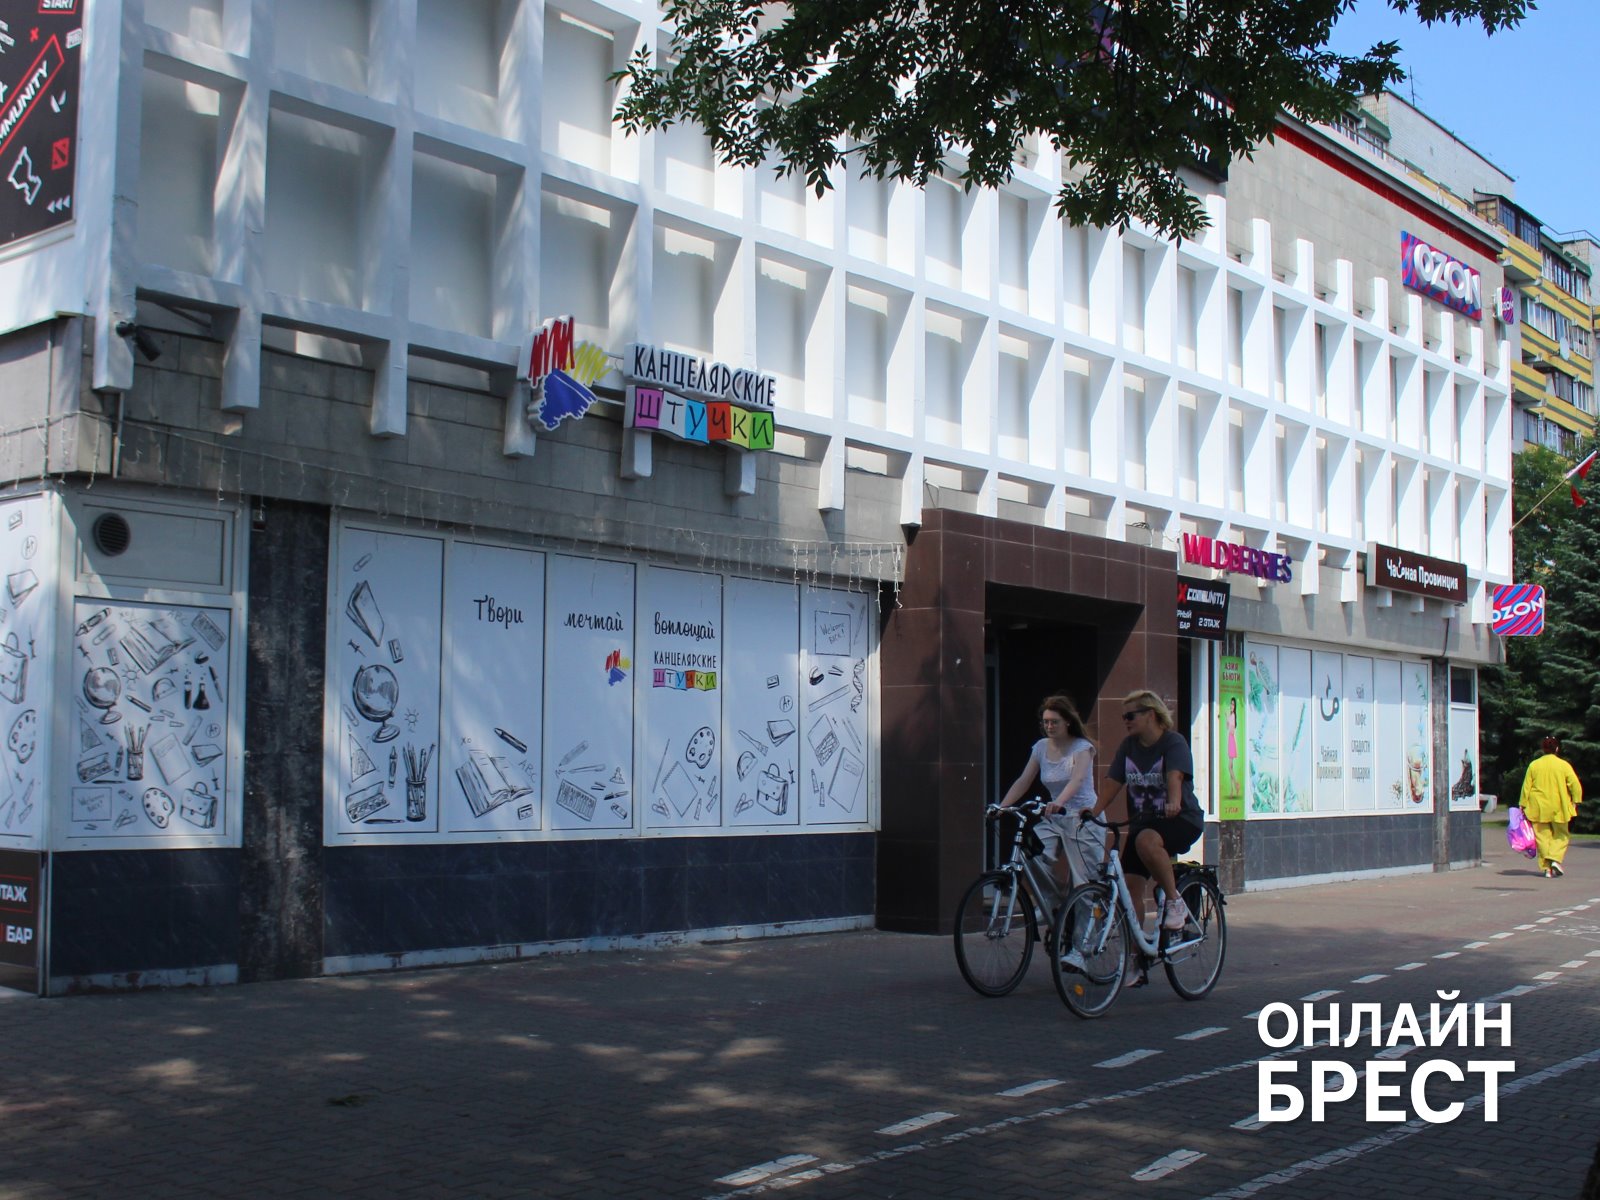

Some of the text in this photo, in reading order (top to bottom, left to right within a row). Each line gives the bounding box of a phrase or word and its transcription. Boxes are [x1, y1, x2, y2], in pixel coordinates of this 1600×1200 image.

[1413, 243, 1481, 311] OZON
[634, 344, 776, 407] КАНЦЕЛЯРСКИЕ
[637, 391, 772, 446] ШТУЧКИ
[1183, 532, 1293, 583] WILDBERRIES
[1418, 565, 1459, 592] Провинция
[473, 594, 715, 642] Твори мечтай воплощай
[1180, 621, 1191, 630] БАР
[654, 650, 717, 669] КАНЦЕЛЯРСКИЕ
[653, 669, 717, 689] ШТУЧКИ
[0, 884, 28, 902] ТАЖ
[6, 925, 33, 944] БАР
